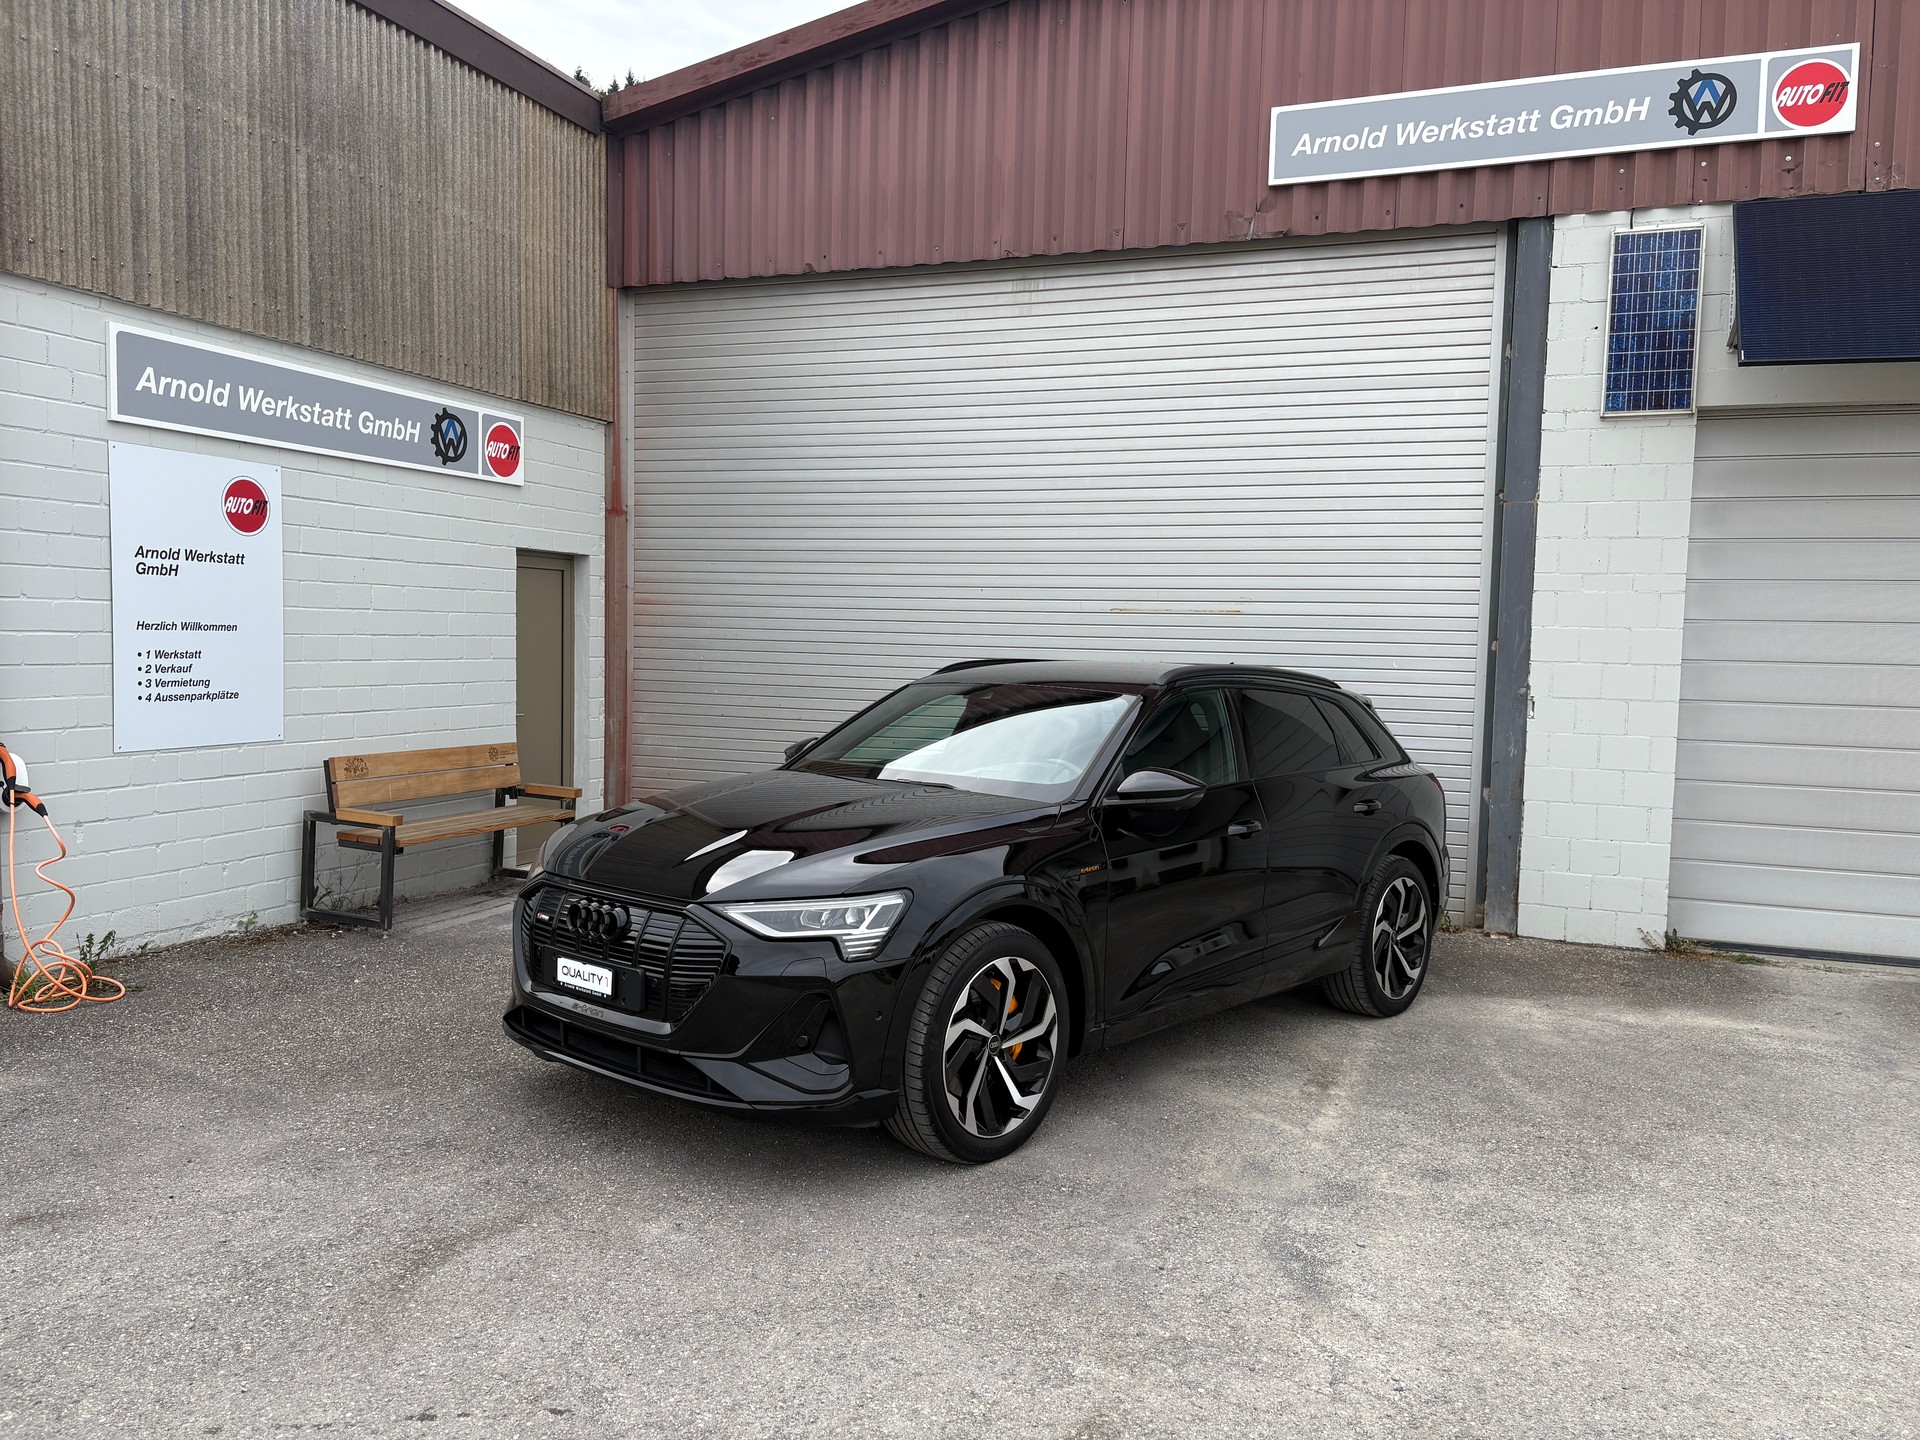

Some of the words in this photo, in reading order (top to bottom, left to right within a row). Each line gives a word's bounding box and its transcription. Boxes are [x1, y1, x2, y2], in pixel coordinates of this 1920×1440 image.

[1776, 81, 1850, 108] AUTOFIT
[1291, 124, 1388, 157] Arnold
[1396, 109, 1541, 146] Werkstatt
[1550, 96, 1651, 130] GmbH
[135, 366, 231, 408] Arnold
[238, 385, 352, 431] Werkstatt
[358, 411, 421, 443] GmbH
[487, 440, 521, 462] AUTOFIT
[225, 496, 268, 516] AUTOFIT
[134, 545, 181, 561] Arnold
[184, 548, 246, 565] Werkstatt
[135, 562, 179, 577] GmbH
[136, 621, 178, 631] Herzlich
[180, 621, 238, 632] Willkommen
[145, 650, 151, 660] 1
[154, 649, 202, 660] Werkstatt
[144, 664, 152, 674] 2
[154, 663, 193, 674] Verkauf
[144, 678, 152, 689] 3
[154, 677, 211, 689] Vermietung
[144, 693, 152, 703] 4
[153, 690, 240, 703] Aussenparkplätze
[561, 965, 604, 986] QUALITY
